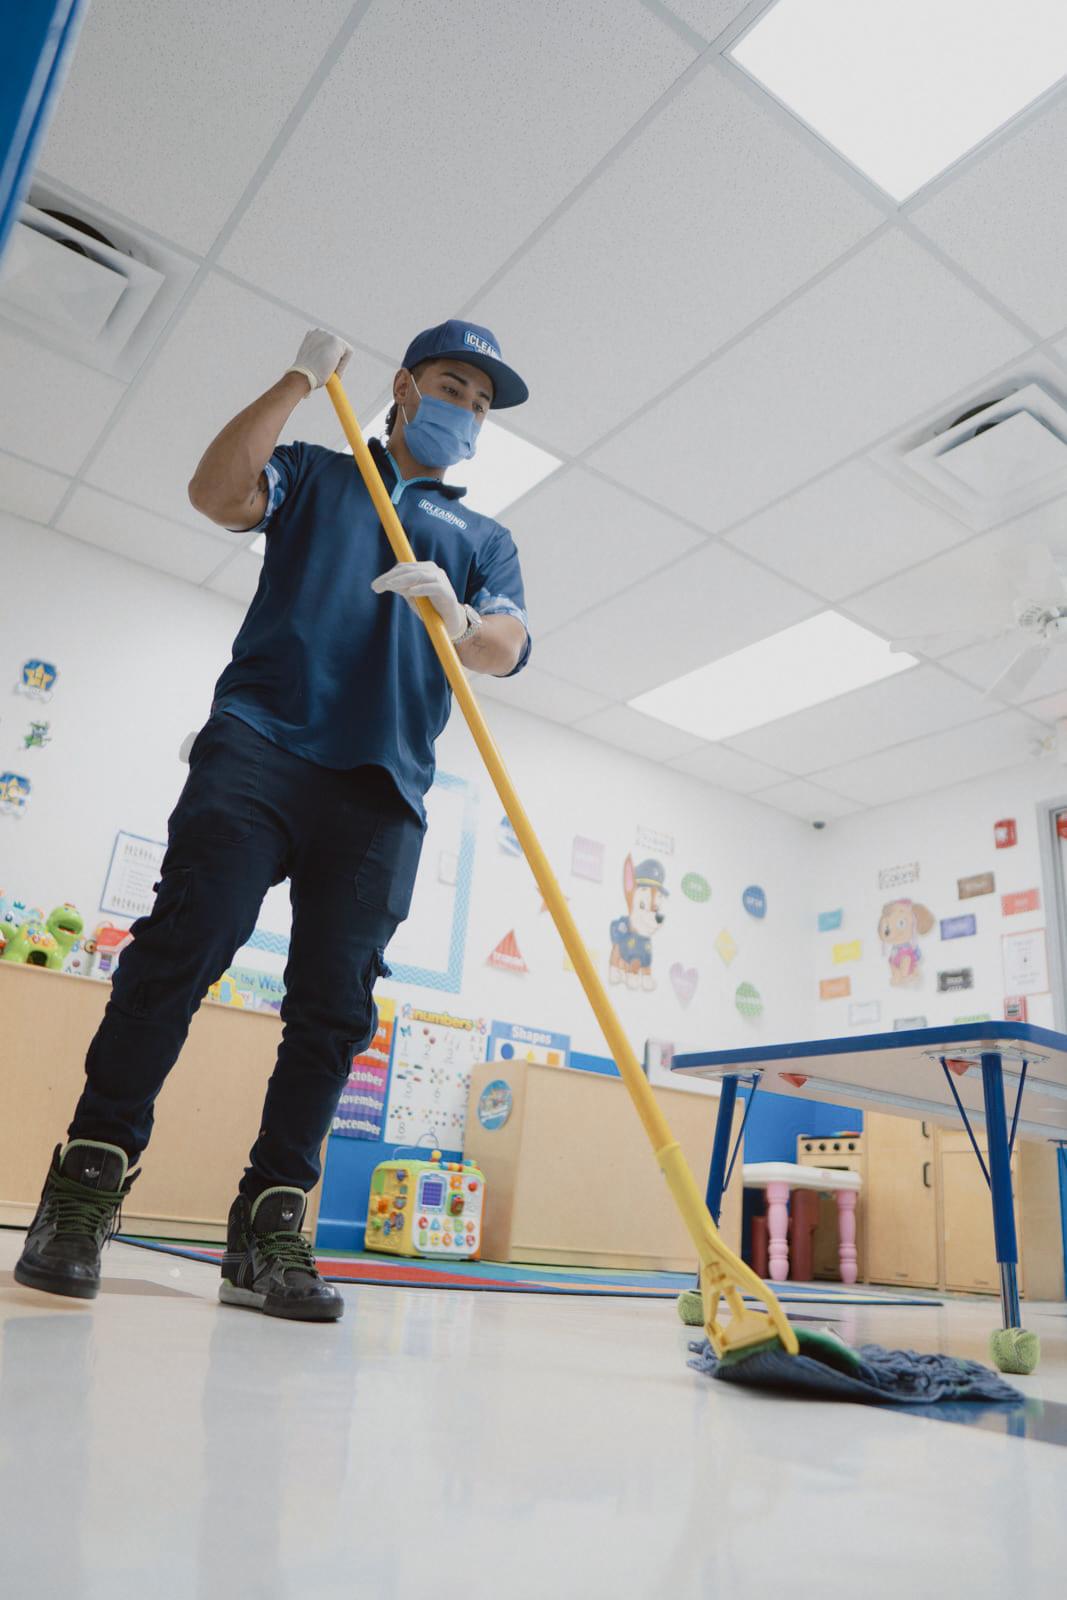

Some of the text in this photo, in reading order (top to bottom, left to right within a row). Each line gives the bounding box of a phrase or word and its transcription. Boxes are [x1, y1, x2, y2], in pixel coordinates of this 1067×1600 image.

[257, 975, 284, 993] Wee
[512, 1025, 552, 1045] Shapes
[348, 1071, 384, 1087] ctober
[332, 1116, 381, 1136] December
